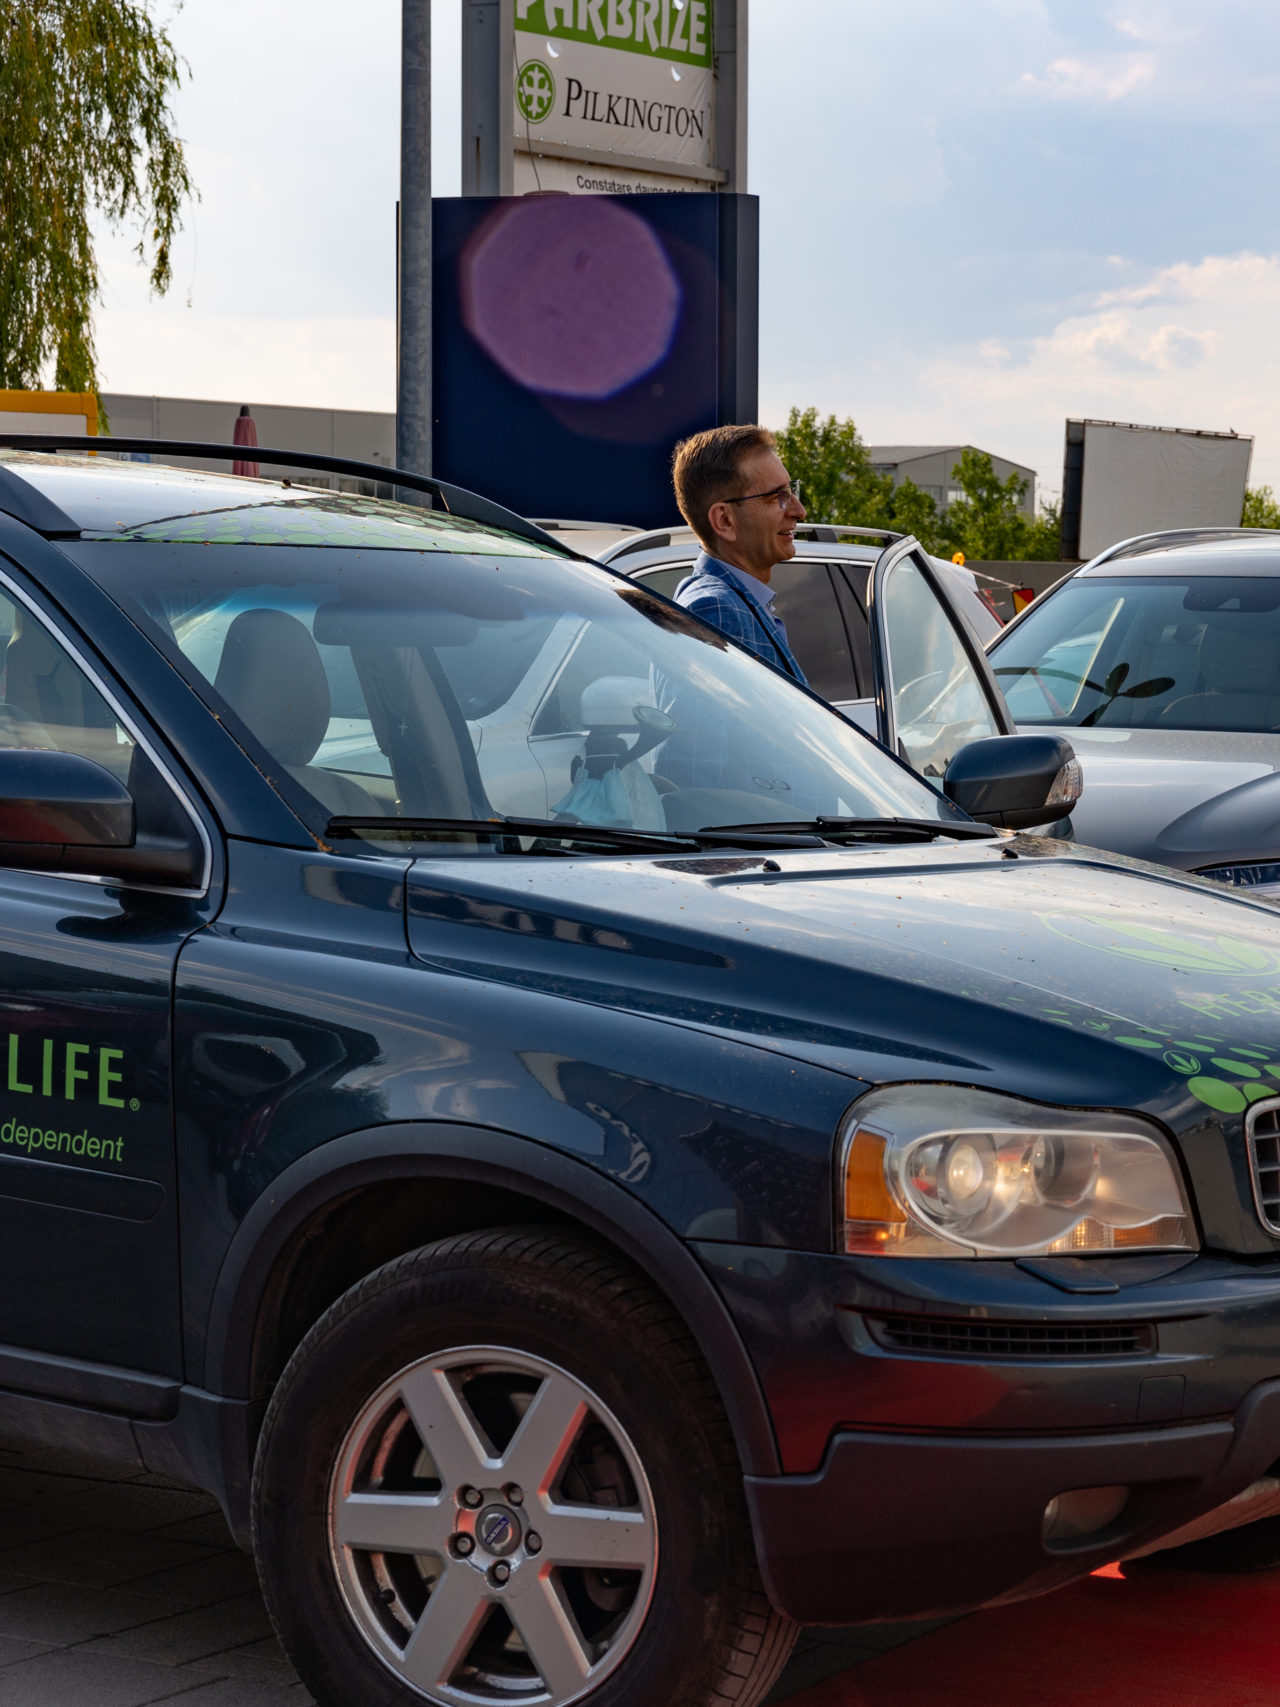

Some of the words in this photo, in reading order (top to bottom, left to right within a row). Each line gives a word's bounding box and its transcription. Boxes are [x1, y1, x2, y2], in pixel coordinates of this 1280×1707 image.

[562, 77, 705, 139] PILKINGTON
[576, 175, 632, 194] Constatare
[0, 1117, 125, 1162] dependent
